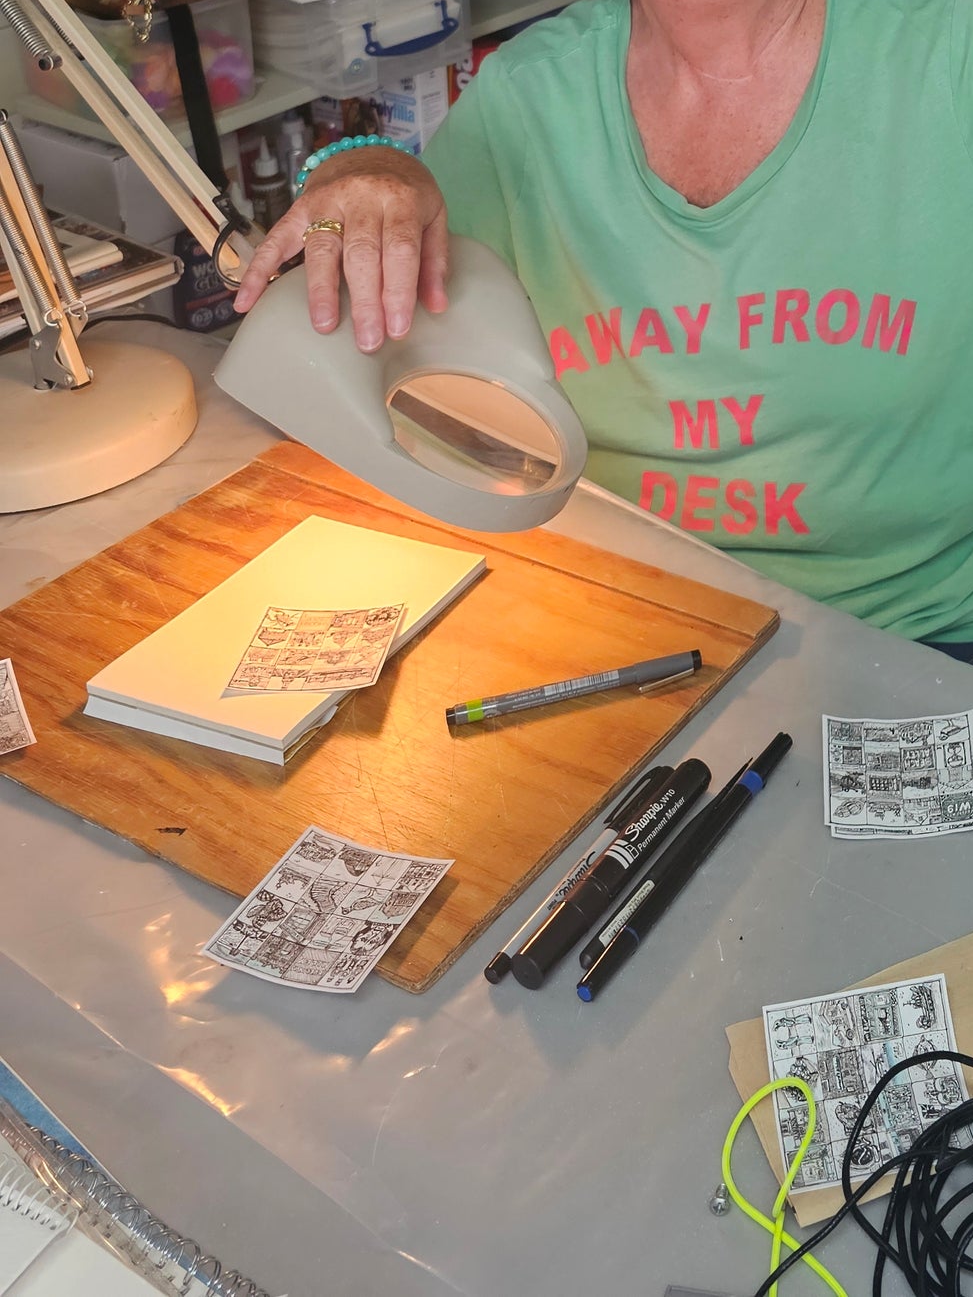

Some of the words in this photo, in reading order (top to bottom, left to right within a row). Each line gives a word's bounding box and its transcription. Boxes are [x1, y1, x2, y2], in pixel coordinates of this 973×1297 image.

[549, 303, 712, 382] AWAY
[737, 288, 917, 356] FROM
[668, 394, 765, 450] MY
[639, 471, 811, 535] DESK
[625, 802, 664, 841] Sharpie
[660, 788, 676, 803] W10
[637, 817, 668, 852] Permanent
[665, 796, 685, 820] Marker
